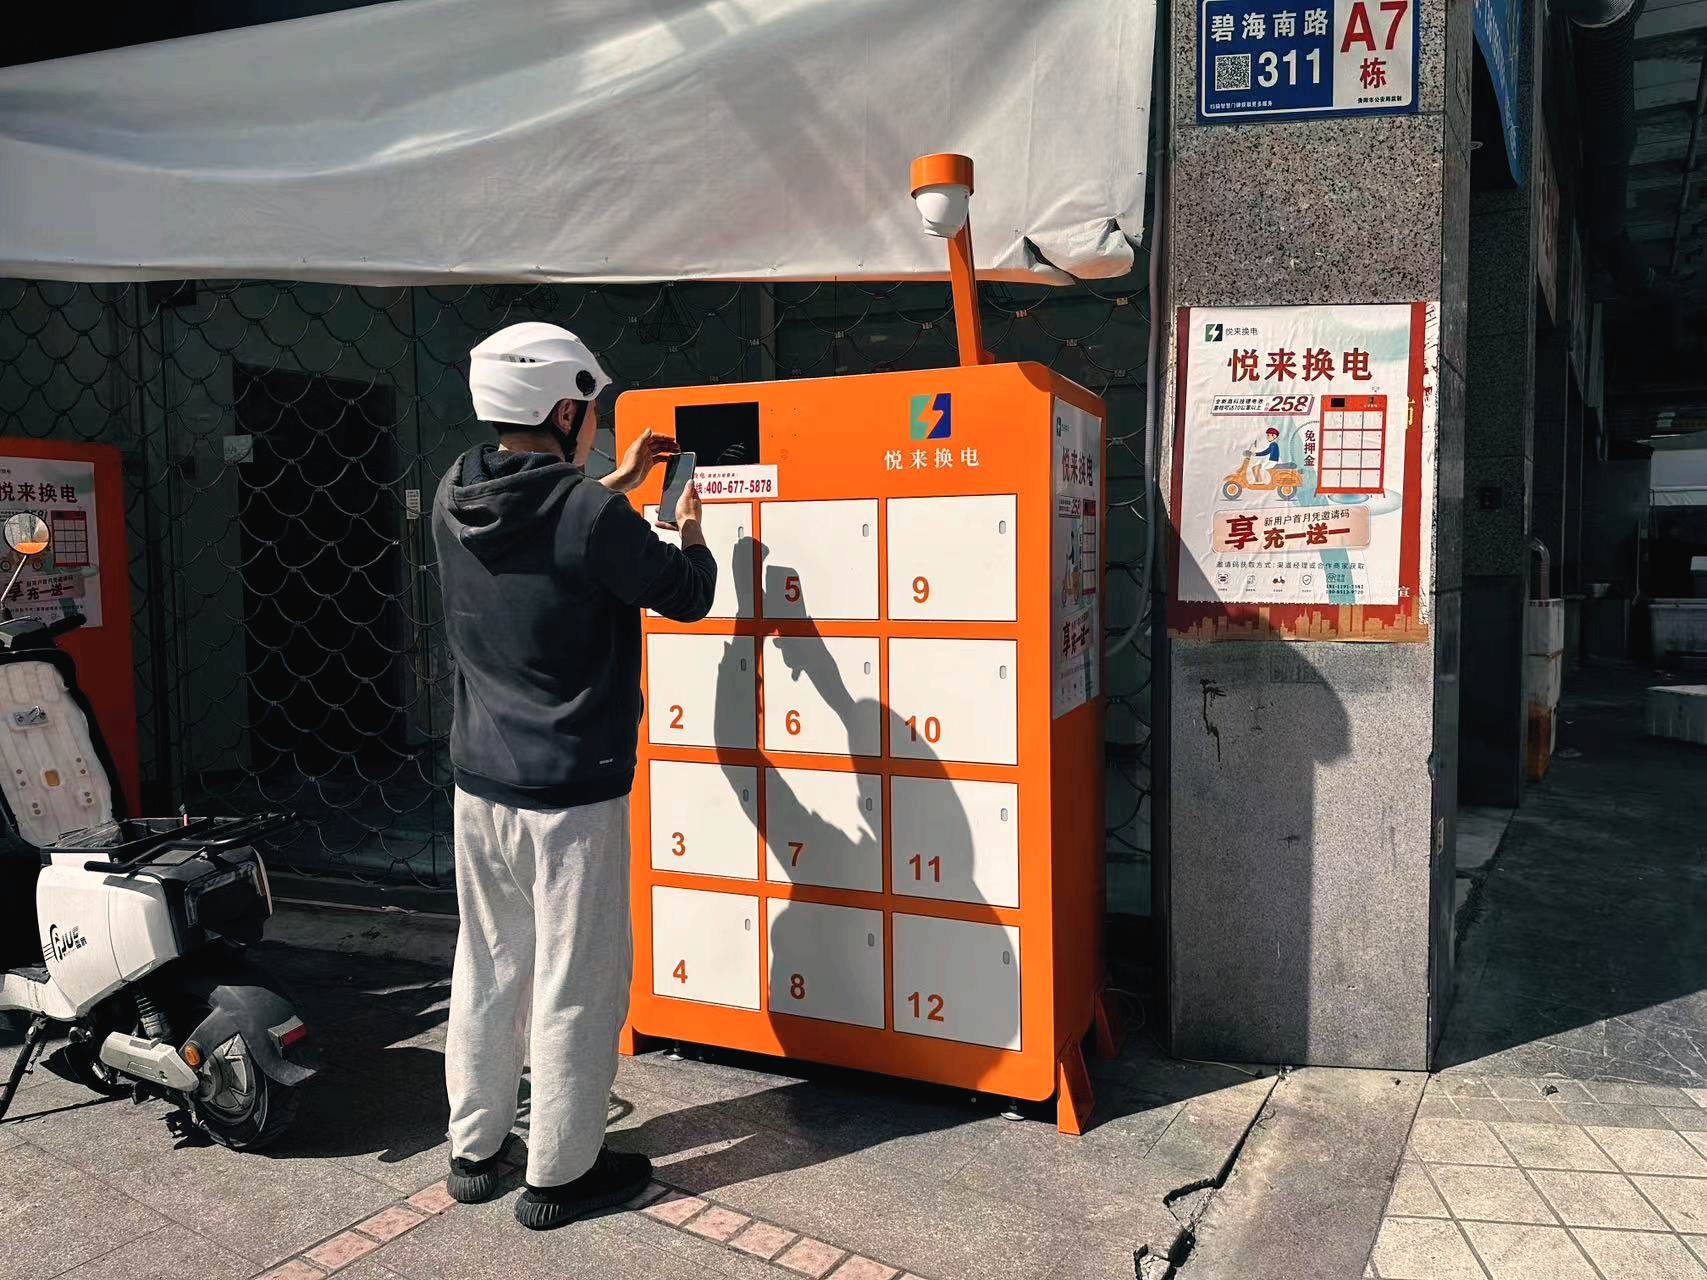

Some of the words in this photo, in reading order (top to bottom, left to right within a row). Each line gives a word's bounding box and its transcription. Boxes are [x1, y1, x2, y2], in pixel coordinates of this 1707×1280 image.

[1210, 8, 1329, 42] 碧海南路
[1340, 1, 1408, 53] A7
[1257, 48, 1321, 88] 311
[1359, 57, 1387, 90] 栋
[1225, 327, 1259, 337] 悦来换电
[1227, 347, 1373, 383] 悦来换电
[1268, 395, 1309, 412] 258
[884, 446, 980, 471] 悦来换电
[1303, 429, 1316, 467] 免押金
[0, 481, 78, 504] 悦来换电
[1263, 508, 1350, 527] 新用户首月凭邀请码
[1225, 515, 1259, 550] 享
[1263, 522, 1351, 550] 充一送一
[784, 576, 800, 603] 5
[912, 576, 930, 603] 9
[669, 704, 684, 730] 2
[785, 710, 801, 736] 6
[904, 716, 941, 743] 10
[671, 832, 686, 857] 3
[788, 842, 804, 868] 7
[908, 854, 941, 883] 11
[673, 960, 688, 984] 4
[790, 973, 806, 1000] 8
[907, 991, 945, 1022] 12
